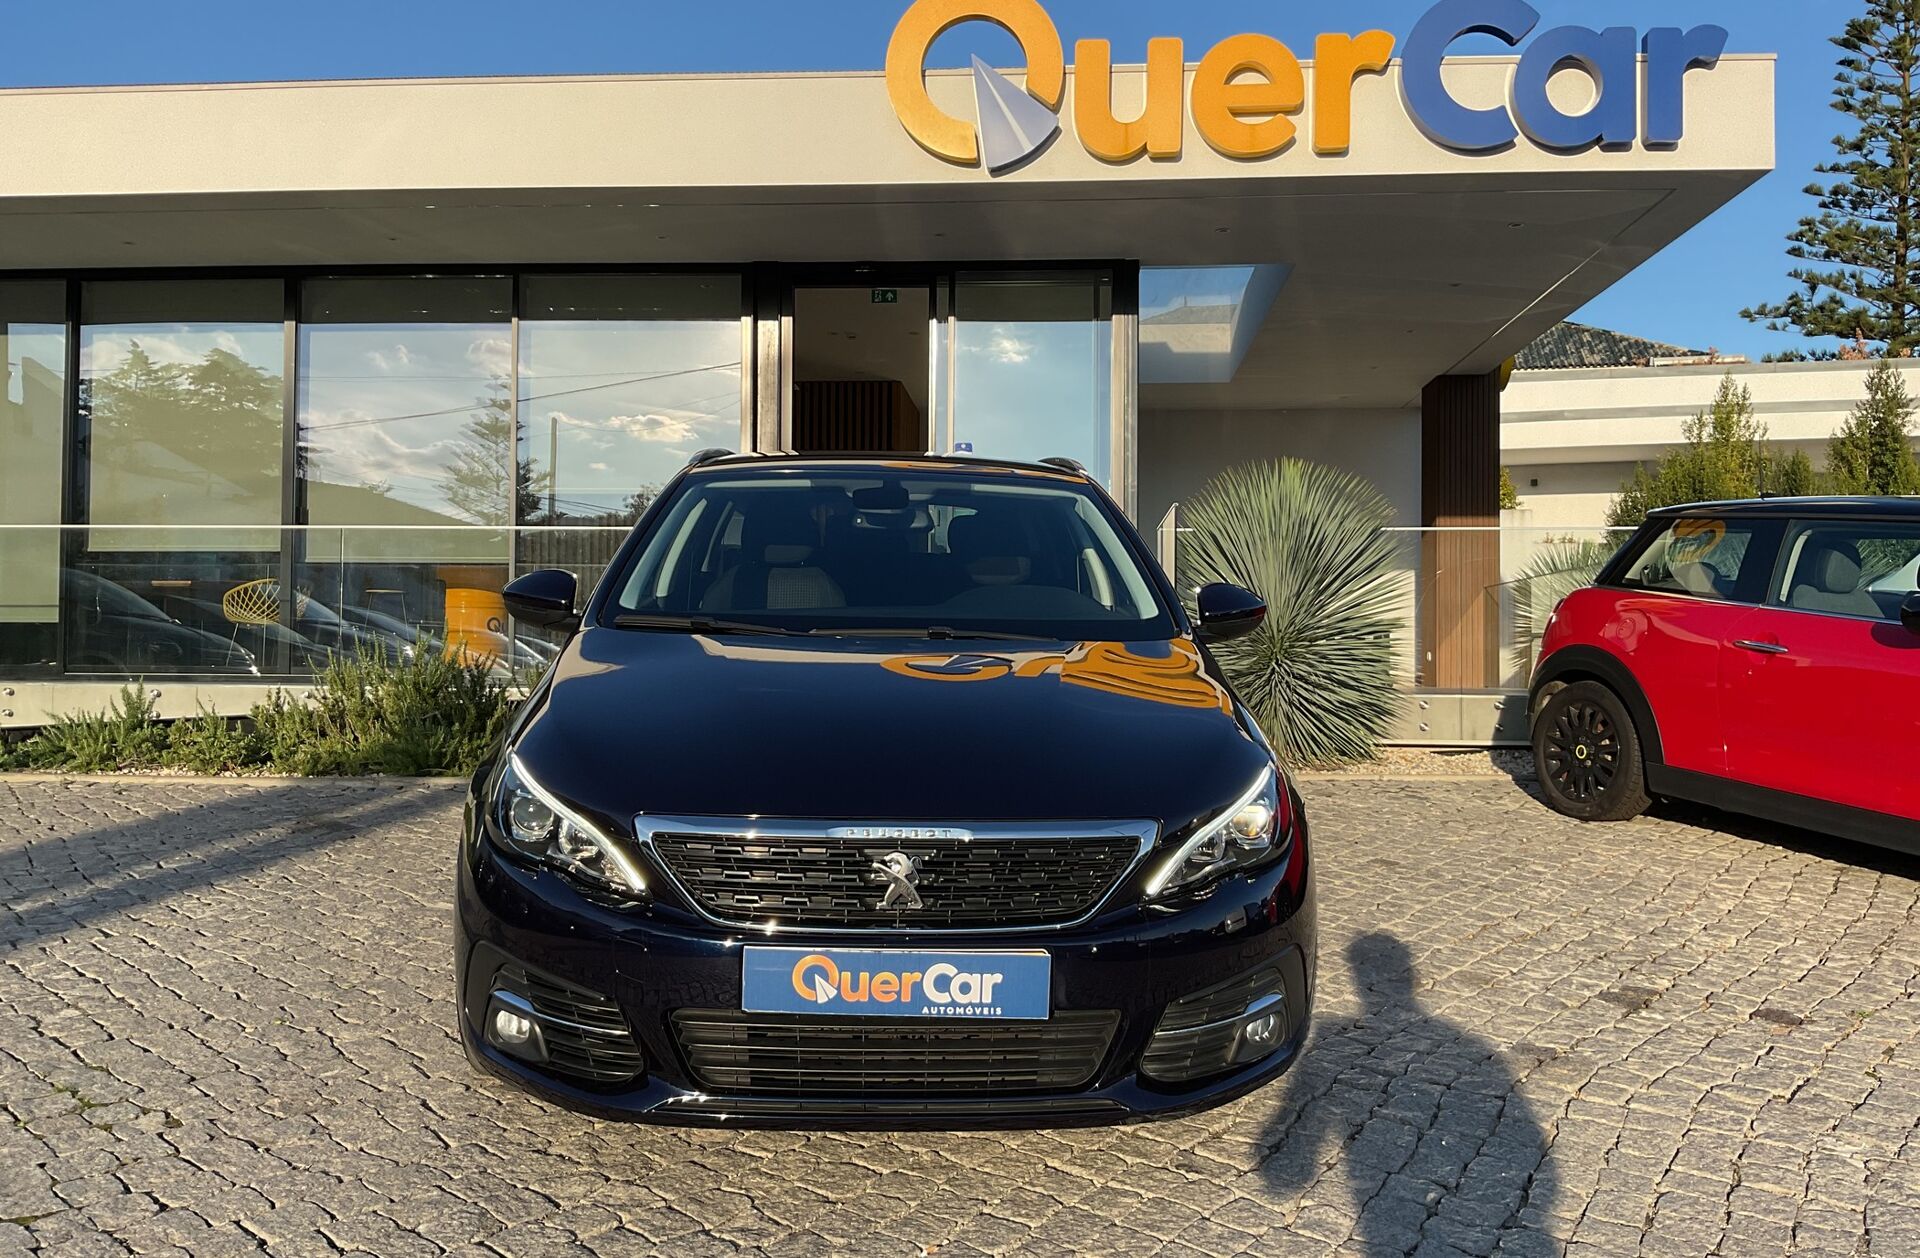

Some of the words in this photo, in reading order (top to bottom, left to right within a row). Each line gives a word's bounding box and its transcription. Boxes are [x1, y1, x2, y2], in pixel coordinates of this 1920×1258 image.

[885, 0, 1729, 175] QuerCar
[846, 828, 952, 838] PEUGEOT
[791, 953, 1004, 1005] QuerCar
[921, 1004, 1003, 1016] AUTOMÓVEIS
